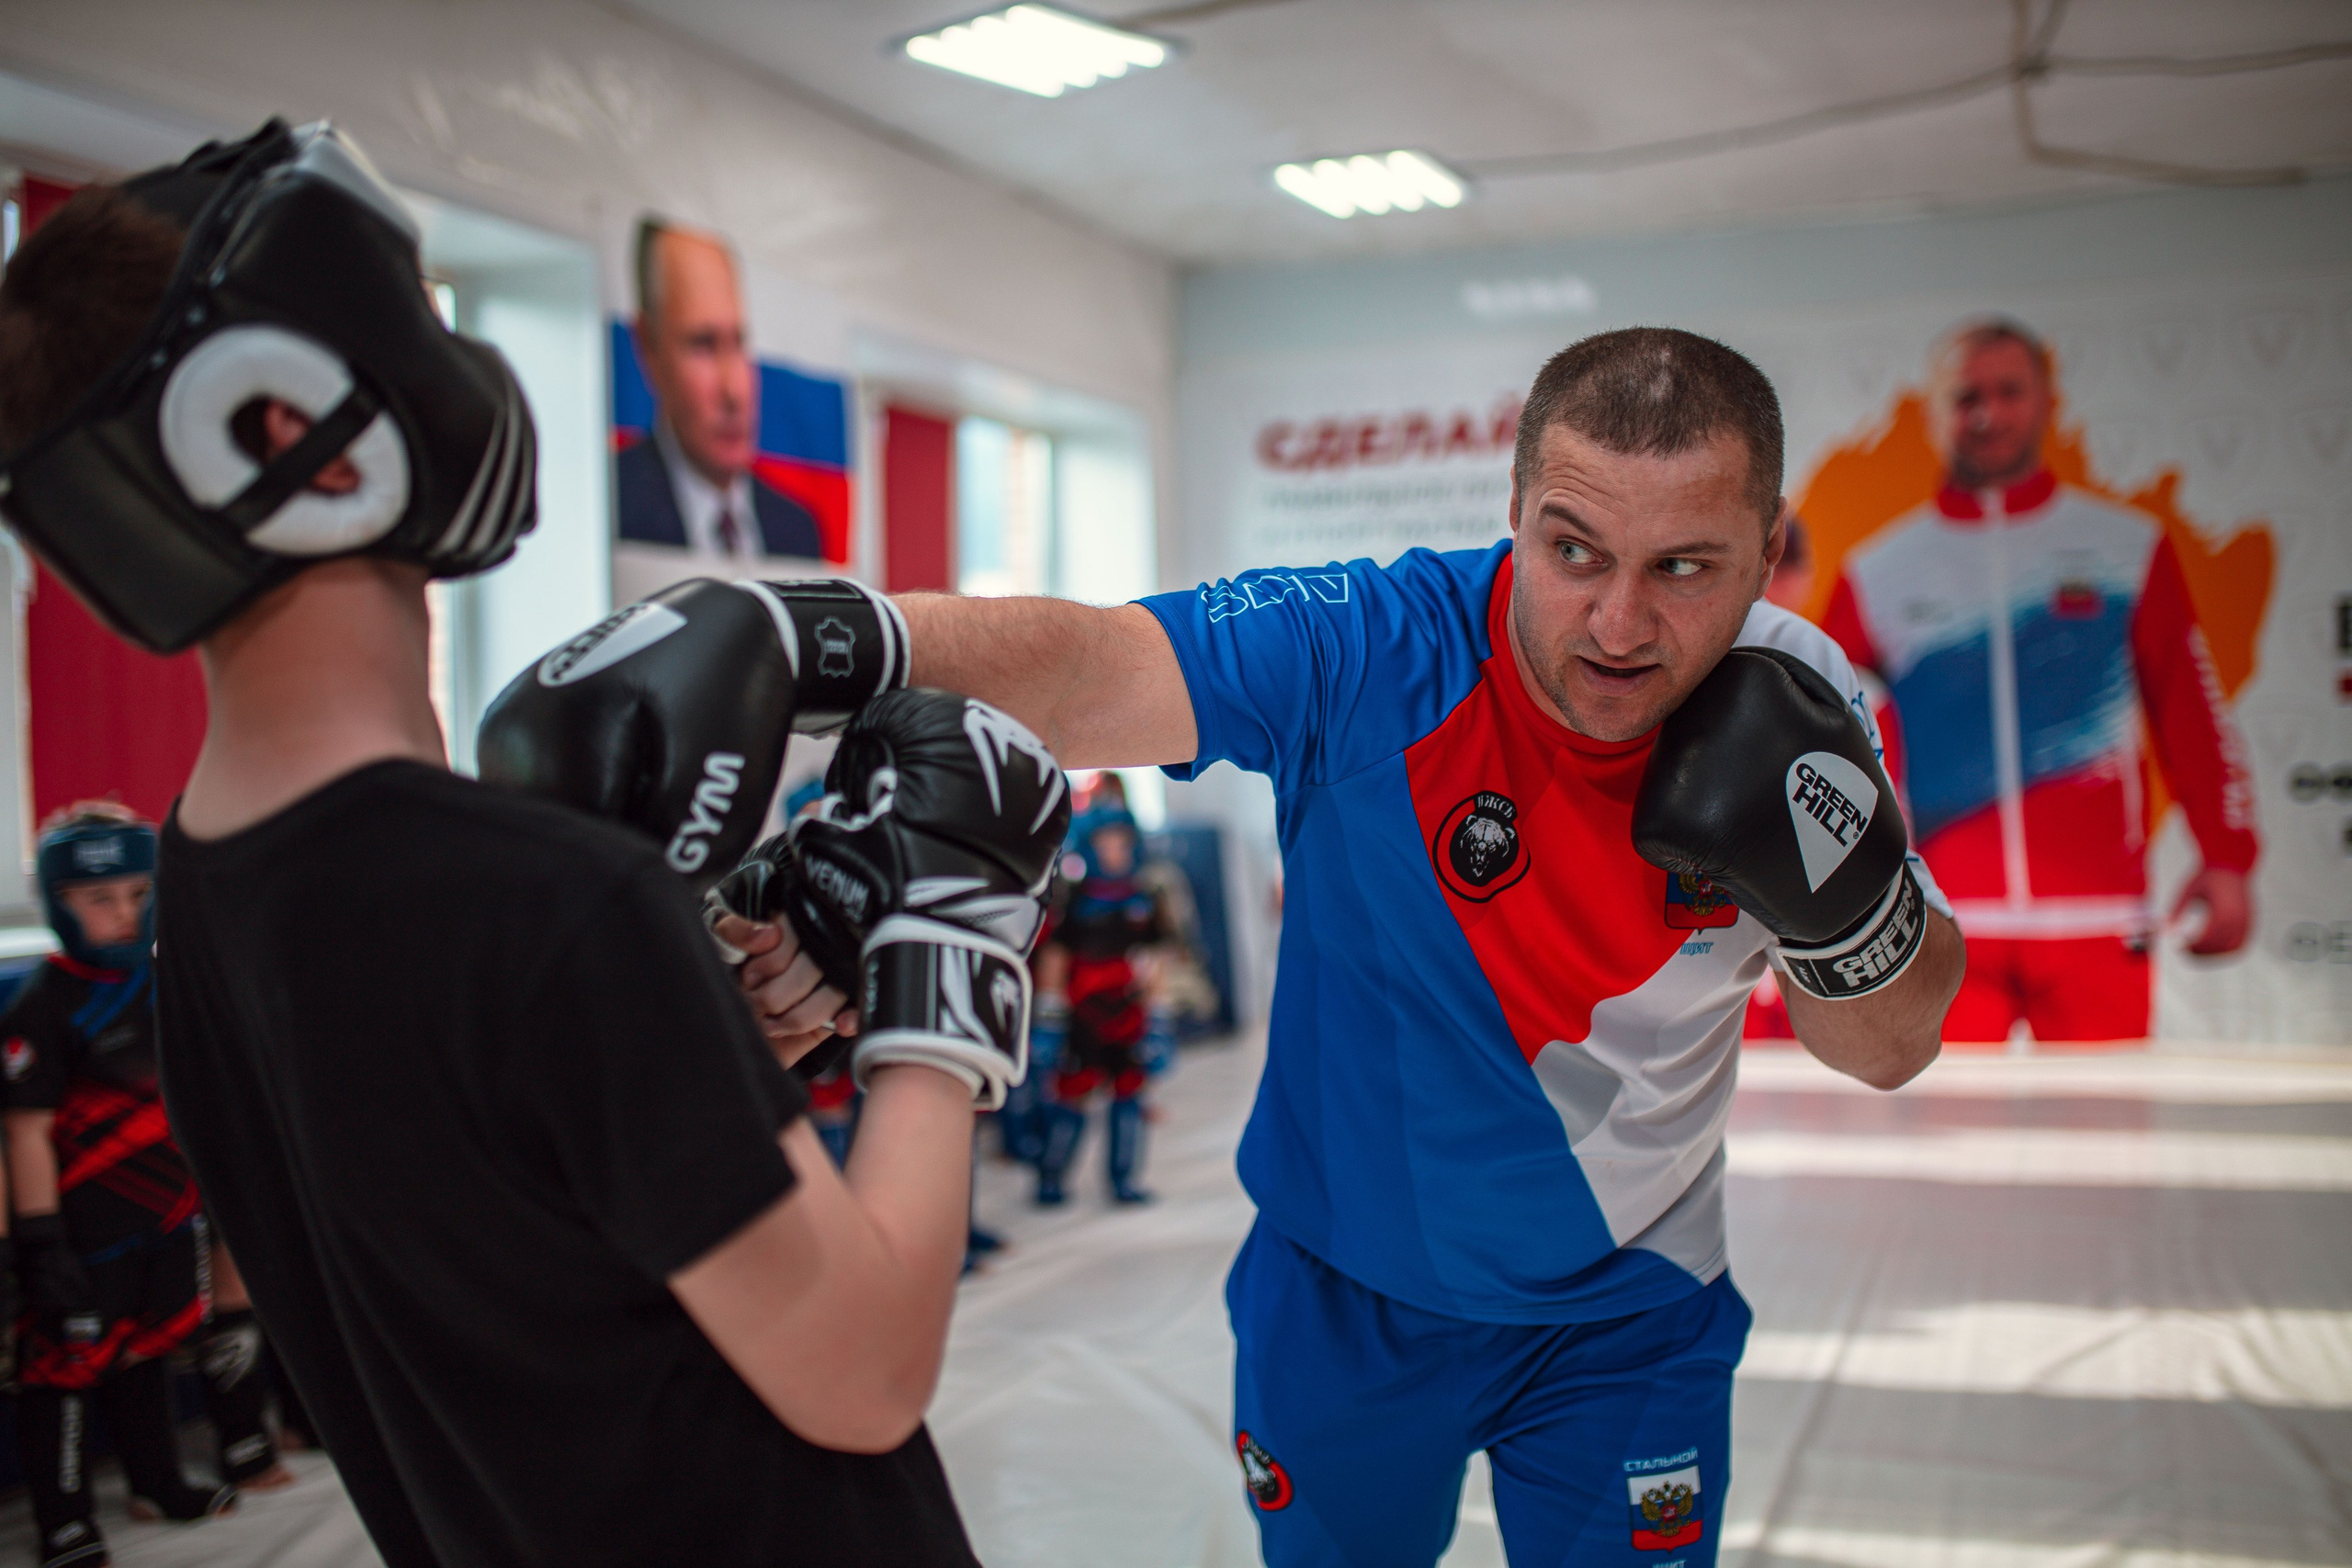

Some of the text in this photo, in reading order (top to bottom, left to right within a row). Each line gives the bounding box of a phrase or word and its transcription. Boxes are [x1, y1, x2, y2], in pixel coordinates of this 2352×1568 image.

[666, 751, 746, 874] GYM
[1792, 782, 1849, 848] HILL
[1795, 762, 1869, 833] GREEN
[1832, 877, 1913, 974] GREEN
[1842, 916, 1918, 988] HILL
[1623, 1447, 1699, 1472] СТАЛЬНОЙ
